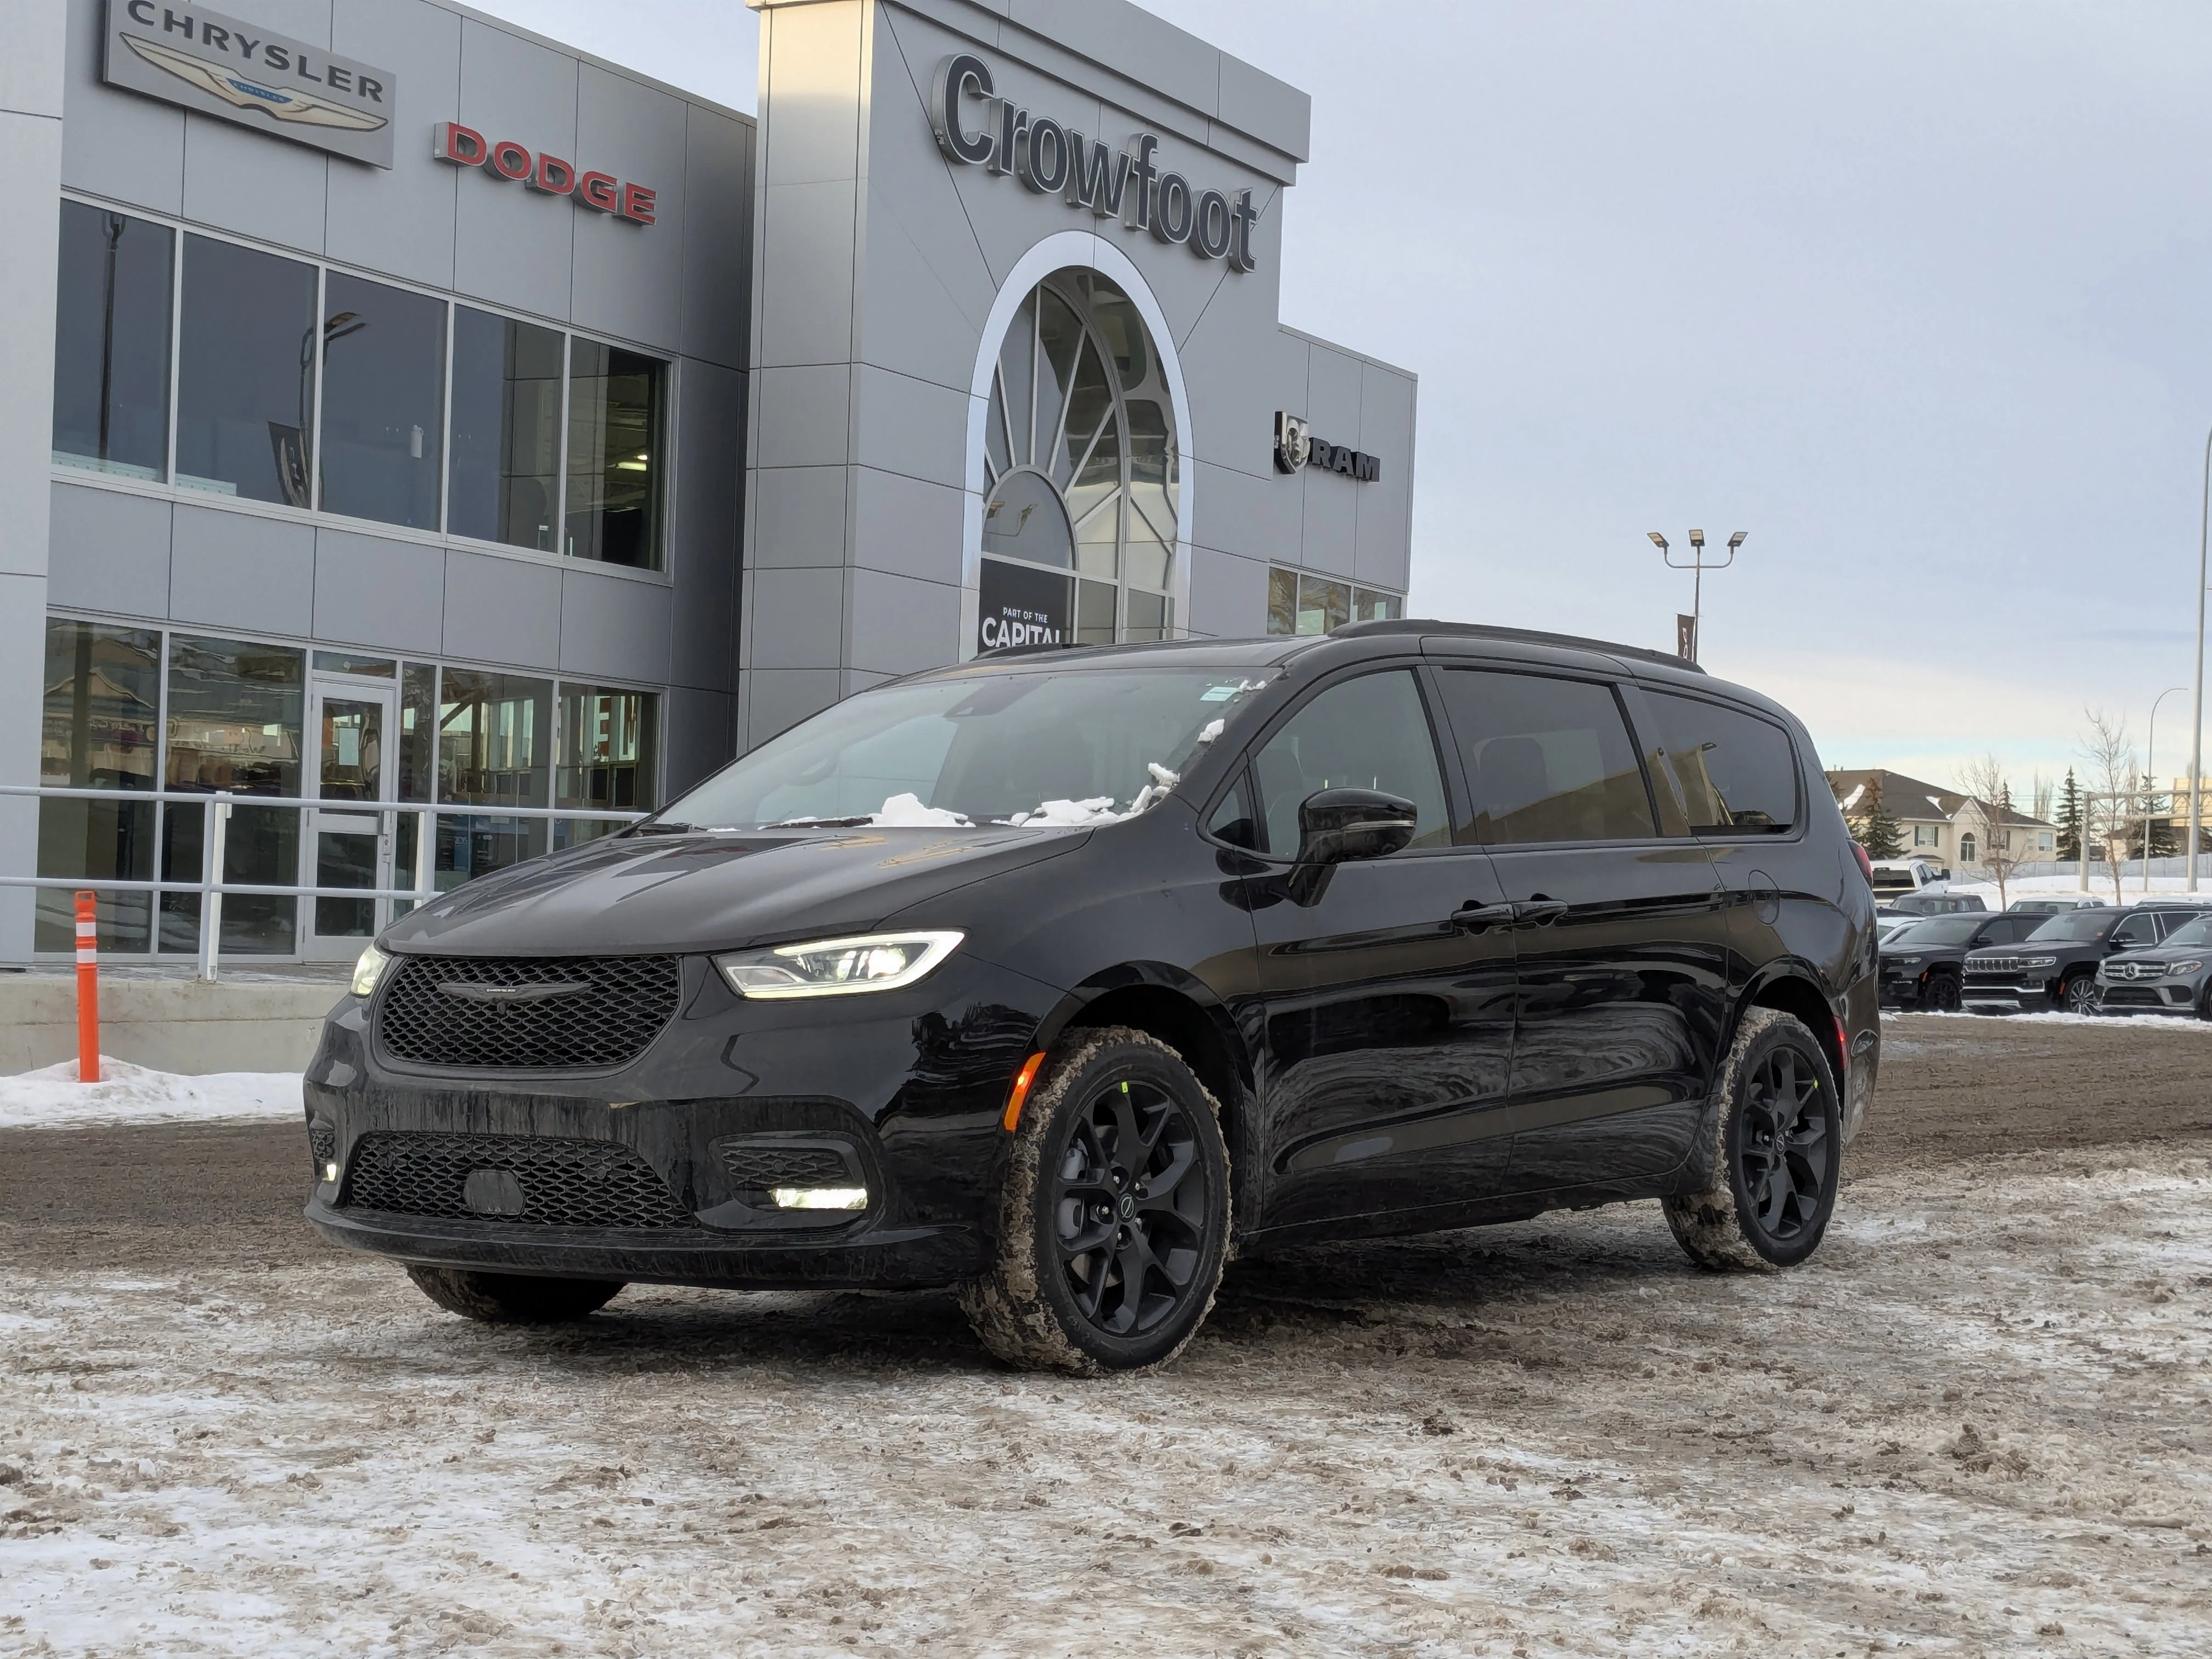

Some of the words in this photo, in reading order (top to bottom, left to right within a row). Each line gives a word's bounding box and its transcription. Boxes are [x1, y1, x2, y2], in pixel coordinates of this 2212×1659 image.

[127, 0, 383, 103] CHRYSLER
[443, 121, 657, 225] DODGE
[939, 53, 1258, 273] Crowfoot
[1311, 437, 1380, 482] RAM
[1003, 607, 1021, 618] PART
[1023, 611, 1033, 620] OF
[1035, 612, 1048, 623] THE
